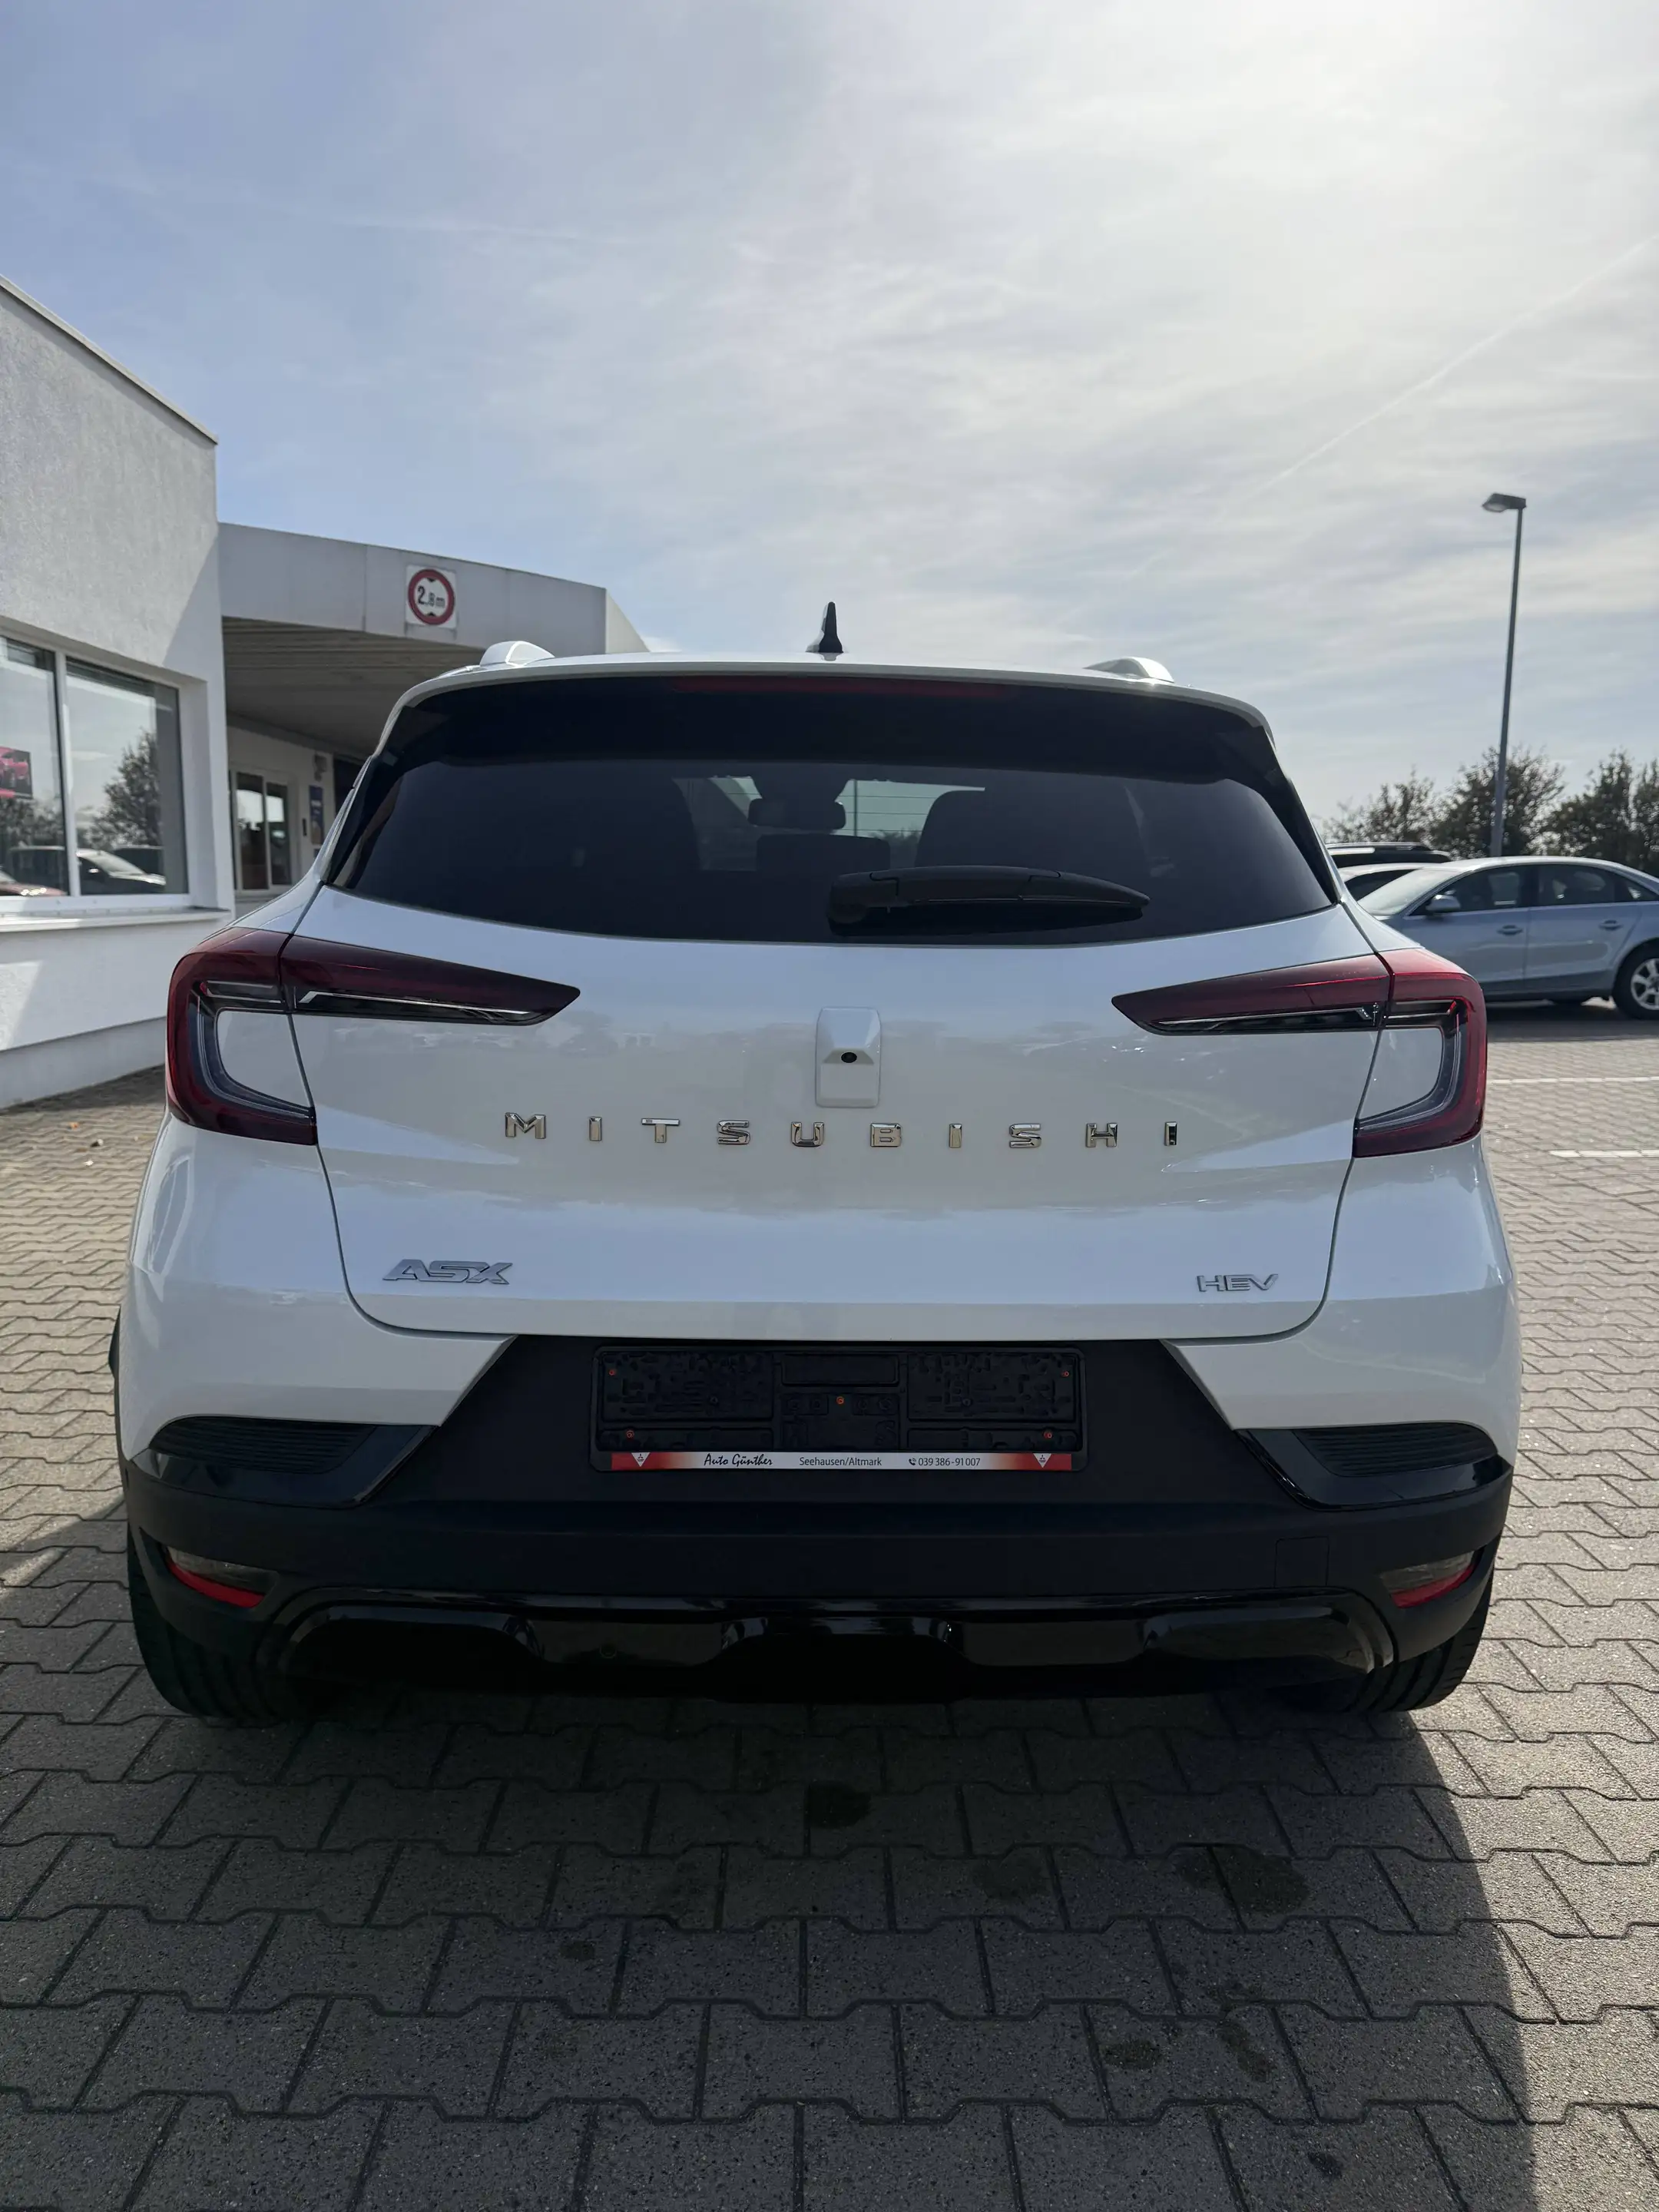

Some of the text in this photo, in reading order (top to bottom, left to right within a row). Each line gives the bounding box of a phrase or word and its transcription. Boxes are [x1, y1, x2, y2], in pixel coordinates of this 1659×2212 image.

[505, 1111, 1177, 1149] MITSUBISHI
[382, 1259, 513, 1285] ASX
[1197, 1273, 1279, 1292] HEV
[704, 1453, 728, 1465] Auto
[732, 1453, 773, 1467] Günther
[799, 1456, 882, 1465] Seehausen/Altmark
